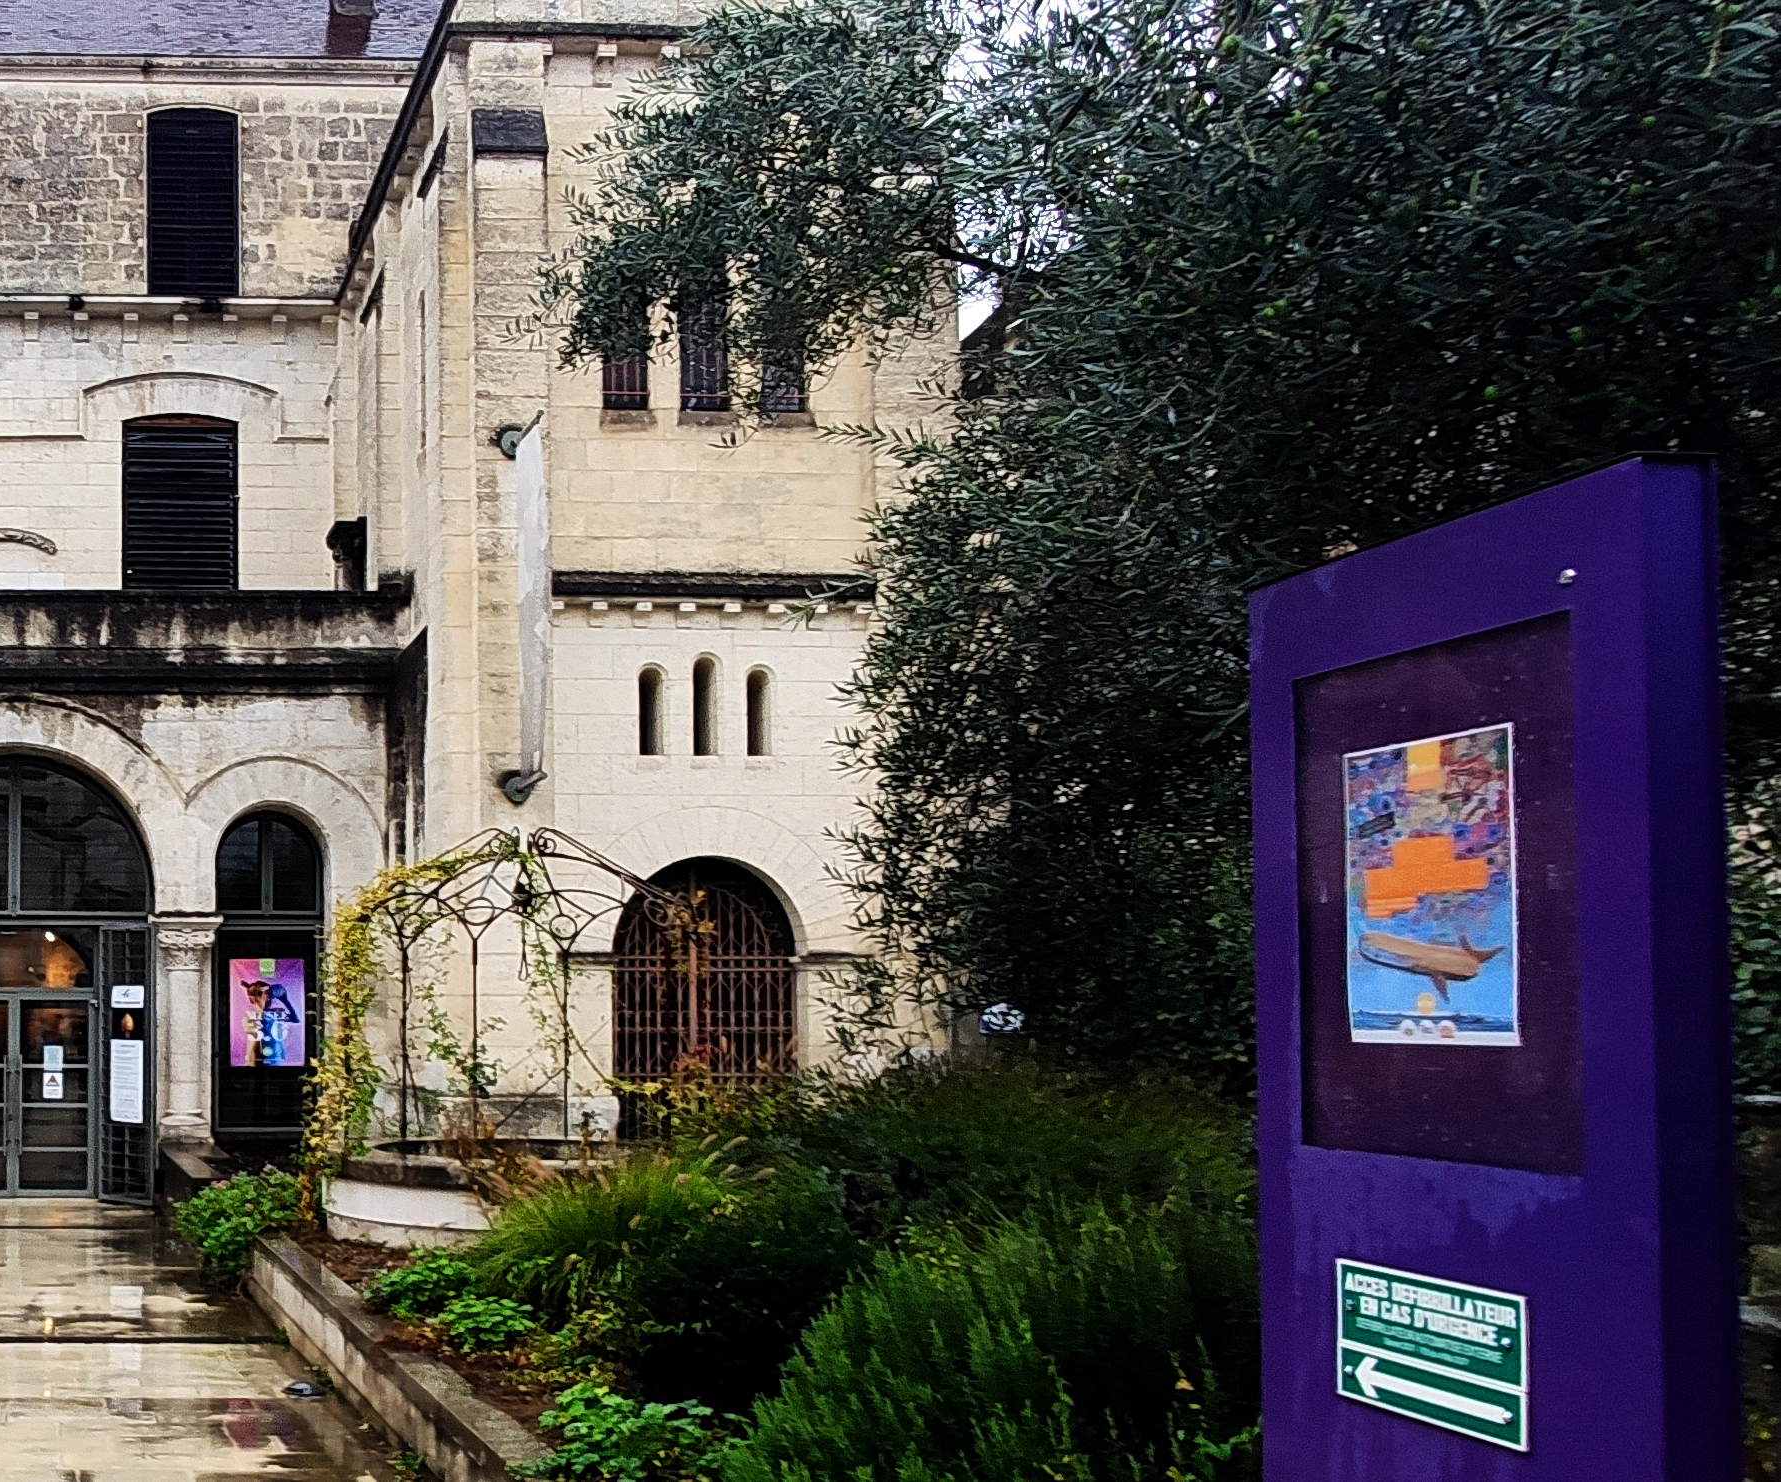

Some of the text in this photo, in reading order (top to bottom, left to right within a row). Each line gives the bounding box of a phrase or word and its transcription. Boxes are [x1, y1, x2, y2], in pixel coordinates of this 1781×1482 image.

[1359, 1296, 1378, 1317] EN
[1380, 1301, 1411, 1325] CAS
[1413, 1308, 1499, 1347] D'URGENCE
[1391, 1282, 1517, 1329] DEFIBRILLATEUR
